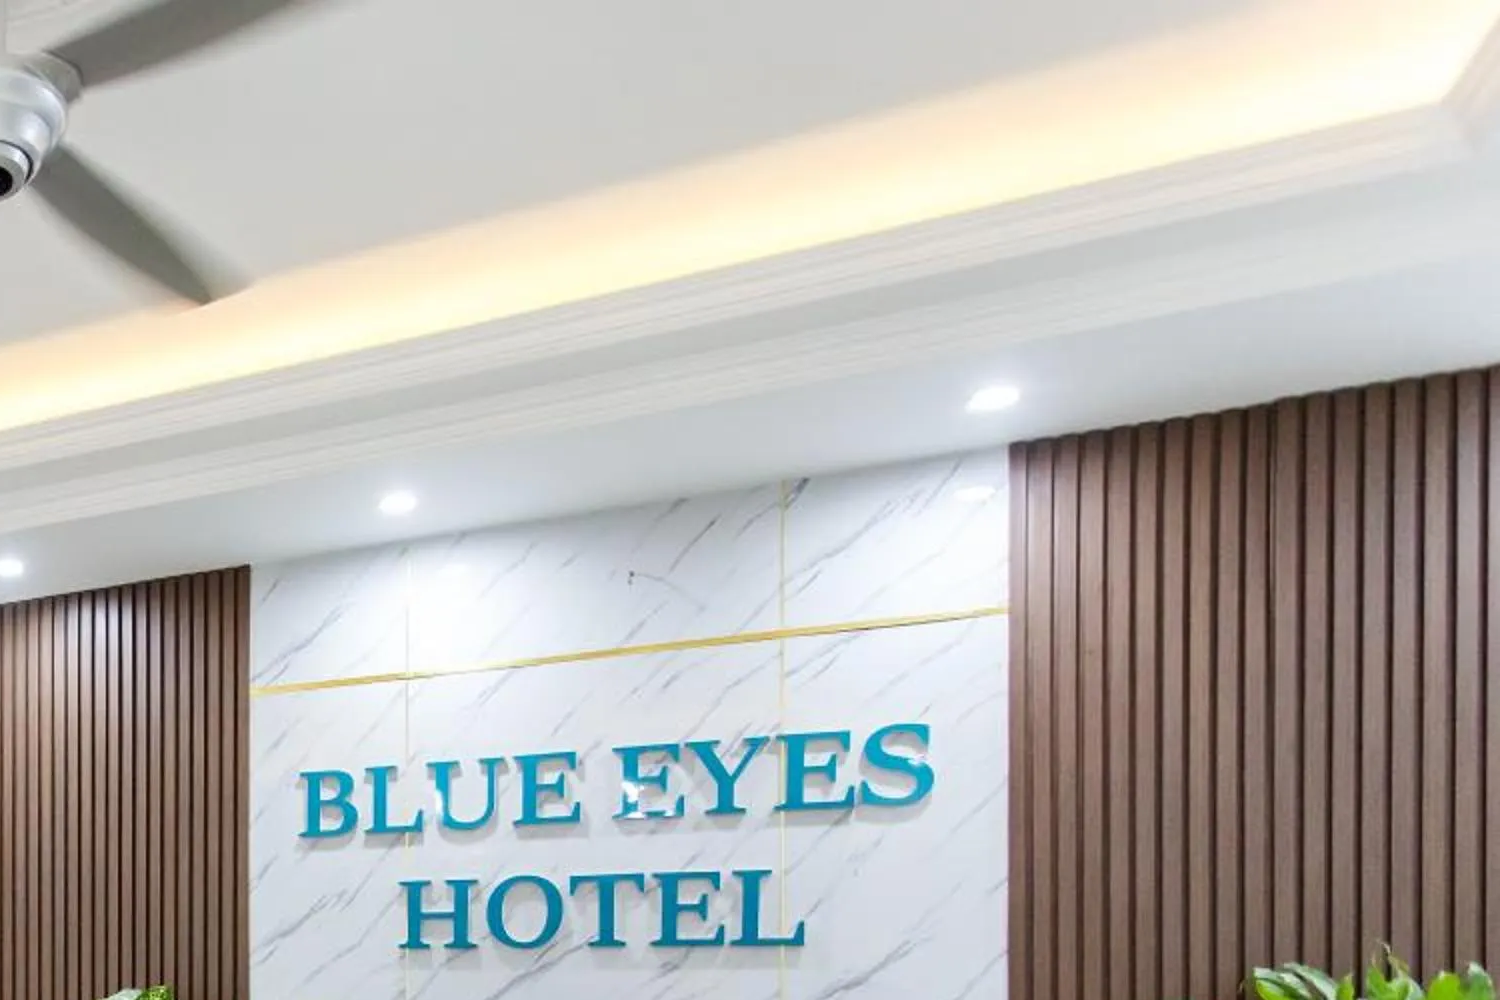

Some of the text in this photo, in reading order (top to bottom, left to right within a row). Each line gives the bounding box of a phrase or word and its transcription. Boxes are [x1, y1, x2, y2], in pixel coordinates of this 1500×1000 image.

[301, 724, 934, 838] BLUE EYES
[400, 870, 804, 949] HOTEL
